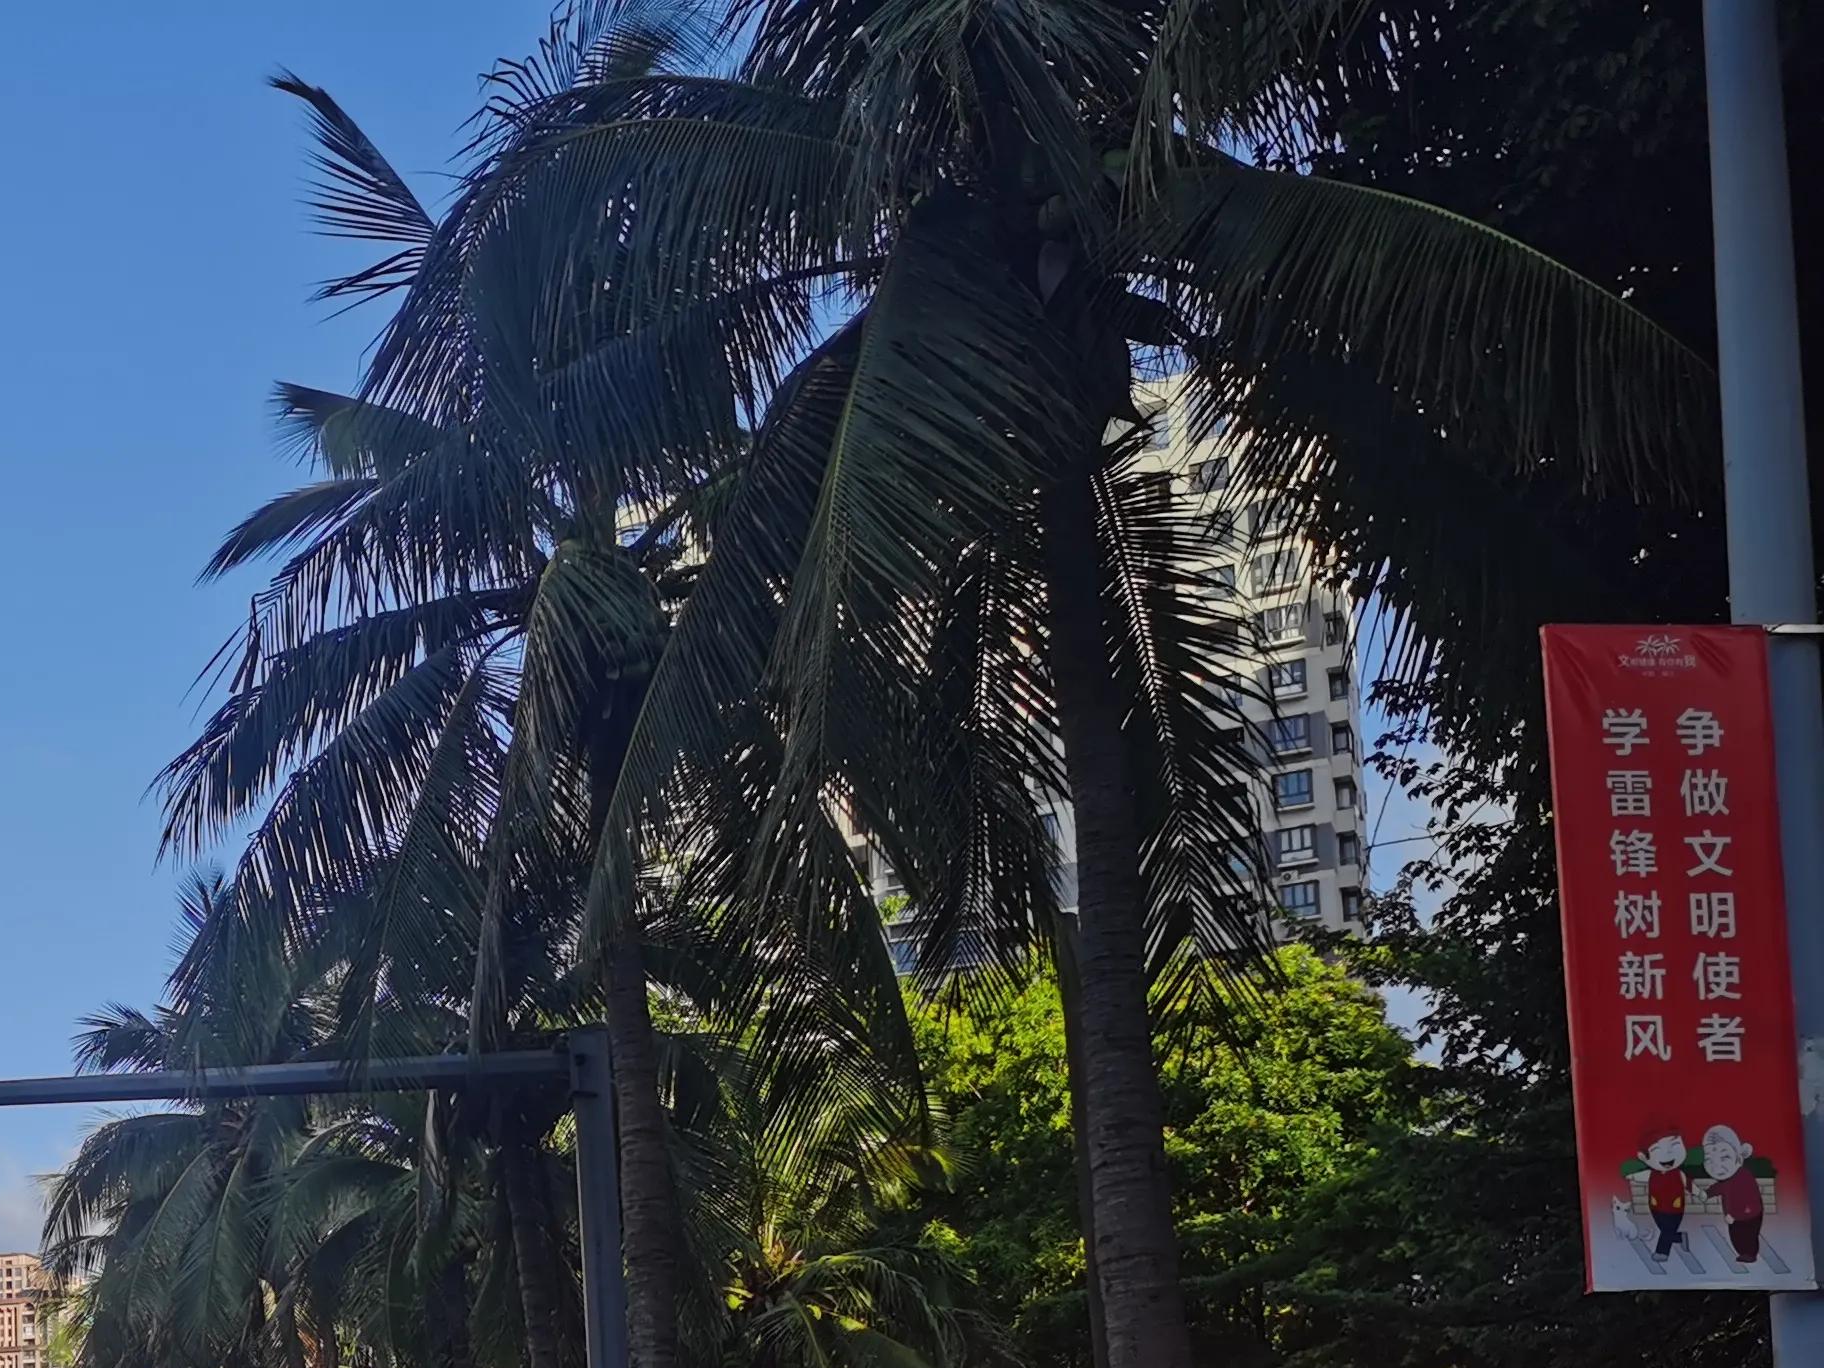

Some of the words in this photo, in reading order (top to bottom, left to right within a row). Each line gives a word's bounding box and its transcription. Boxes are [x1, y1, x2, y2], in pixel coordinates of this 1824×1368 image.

[1602, 708, 1672, 1062] 学雷锋树新风
[1676, 708, 1745, 1062] 争做文明使者
